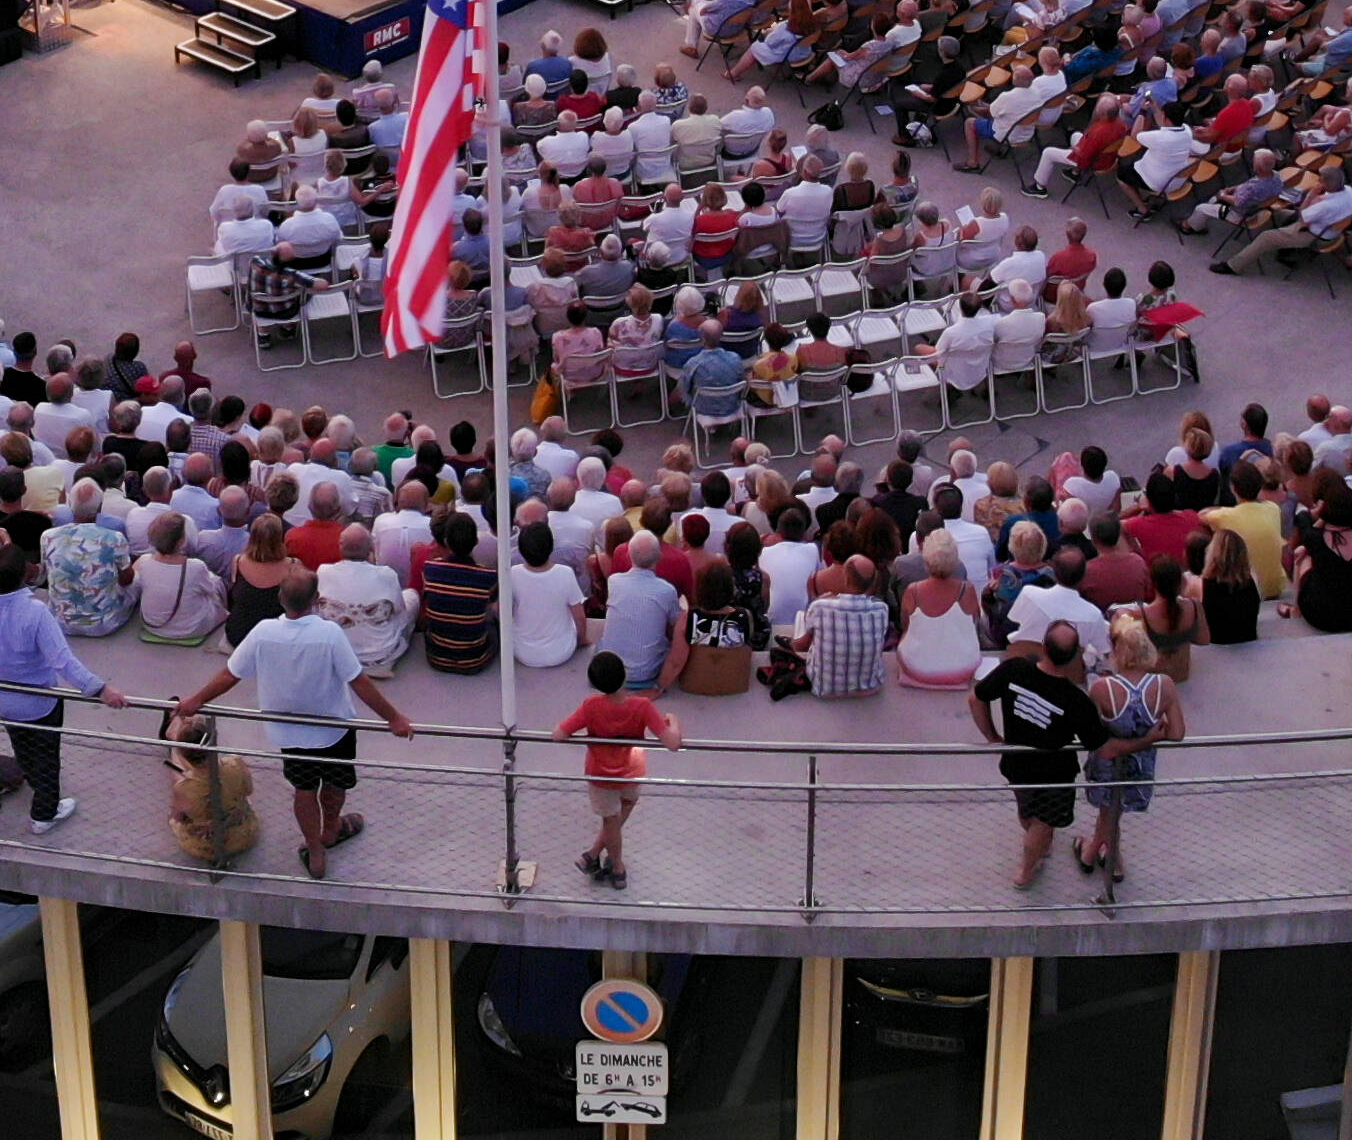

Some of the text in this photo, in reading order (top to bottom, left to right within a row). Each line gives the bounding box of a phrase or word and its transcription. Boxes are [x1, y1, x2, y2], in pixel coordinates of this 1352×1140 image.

[373, 22, 401, 46] RMC
[581, 1053, 663, 1067] LE DIMANCHE
[583, 1073, 599, 1085] DE
[626, 1074, 634, 1086] A
